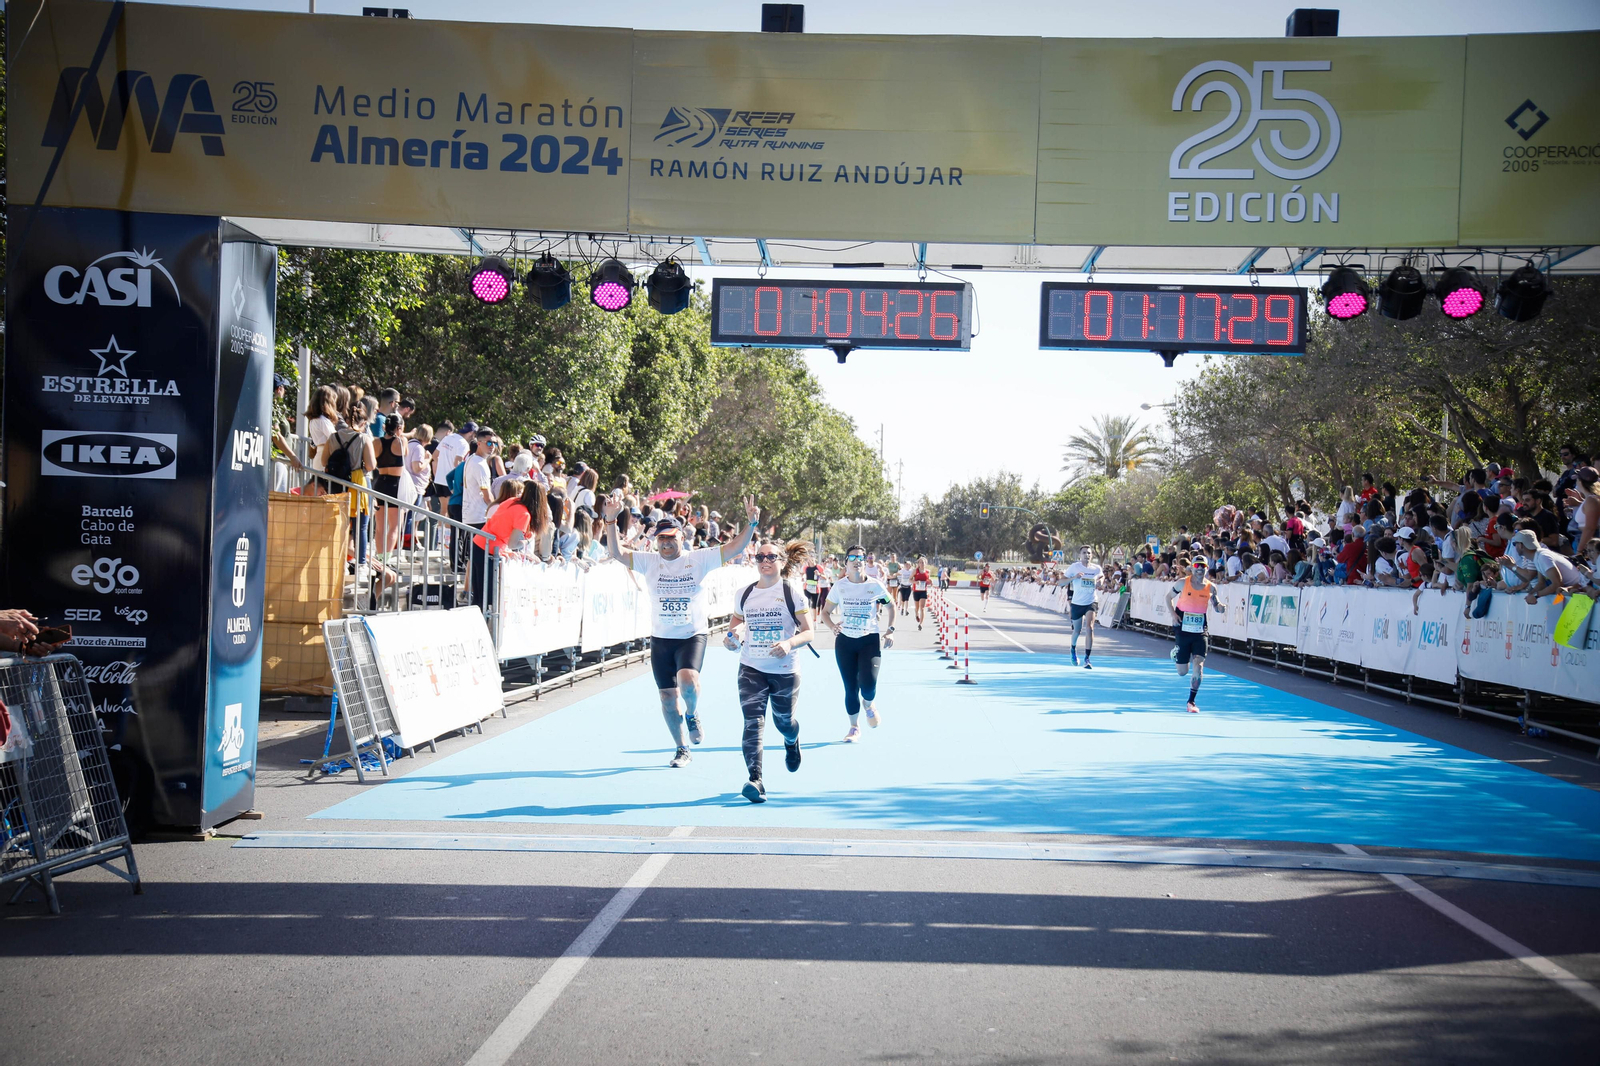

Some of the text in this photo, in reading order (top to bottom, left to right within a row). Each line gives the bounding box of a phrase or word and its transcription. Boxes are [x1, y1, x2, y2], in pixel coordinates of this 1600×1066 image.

[232, 81, 278, 113] 25
[313, 84, 624, 128] Medio Maratón
[231, 114, 278, 125] EDICIÓN
[731, 110, 796, 124] RFEA
[1168, 60, 1342, 180] 25
[724, 126, 789, 138] SERIES
[310, 123, 624, 175] Almería 2024
[719, 139, 825, 150] RUTA RUNNING
[650, 156, 963, 186] RAMÓN RUIZ ANDÚJAR
[1502, 160, 1540, 172] 2005
[1167, 185, 1340, 224] EDICIÓN
[44, 265, 152, 307] CASI
[1084, 290, 1294, 345] 01:17:29
[231, 339, 245, 356] 2005
[41, 376, 181, 397] ESTRELLA
[74, 394, 150, 405] DE LEVANTE
[60, 444, 162, 465] IKEA
[82, 505, 133, 518] Barceló
[81, 519, 135, 532] Cabo de
[81, 533, 112, 545] Gata
[71, 557, 139, 594] ego
[662, 602, 688, 611] 5633
[64, 609, 101, 621] SER
[752, 630, 781, 641] 5543
